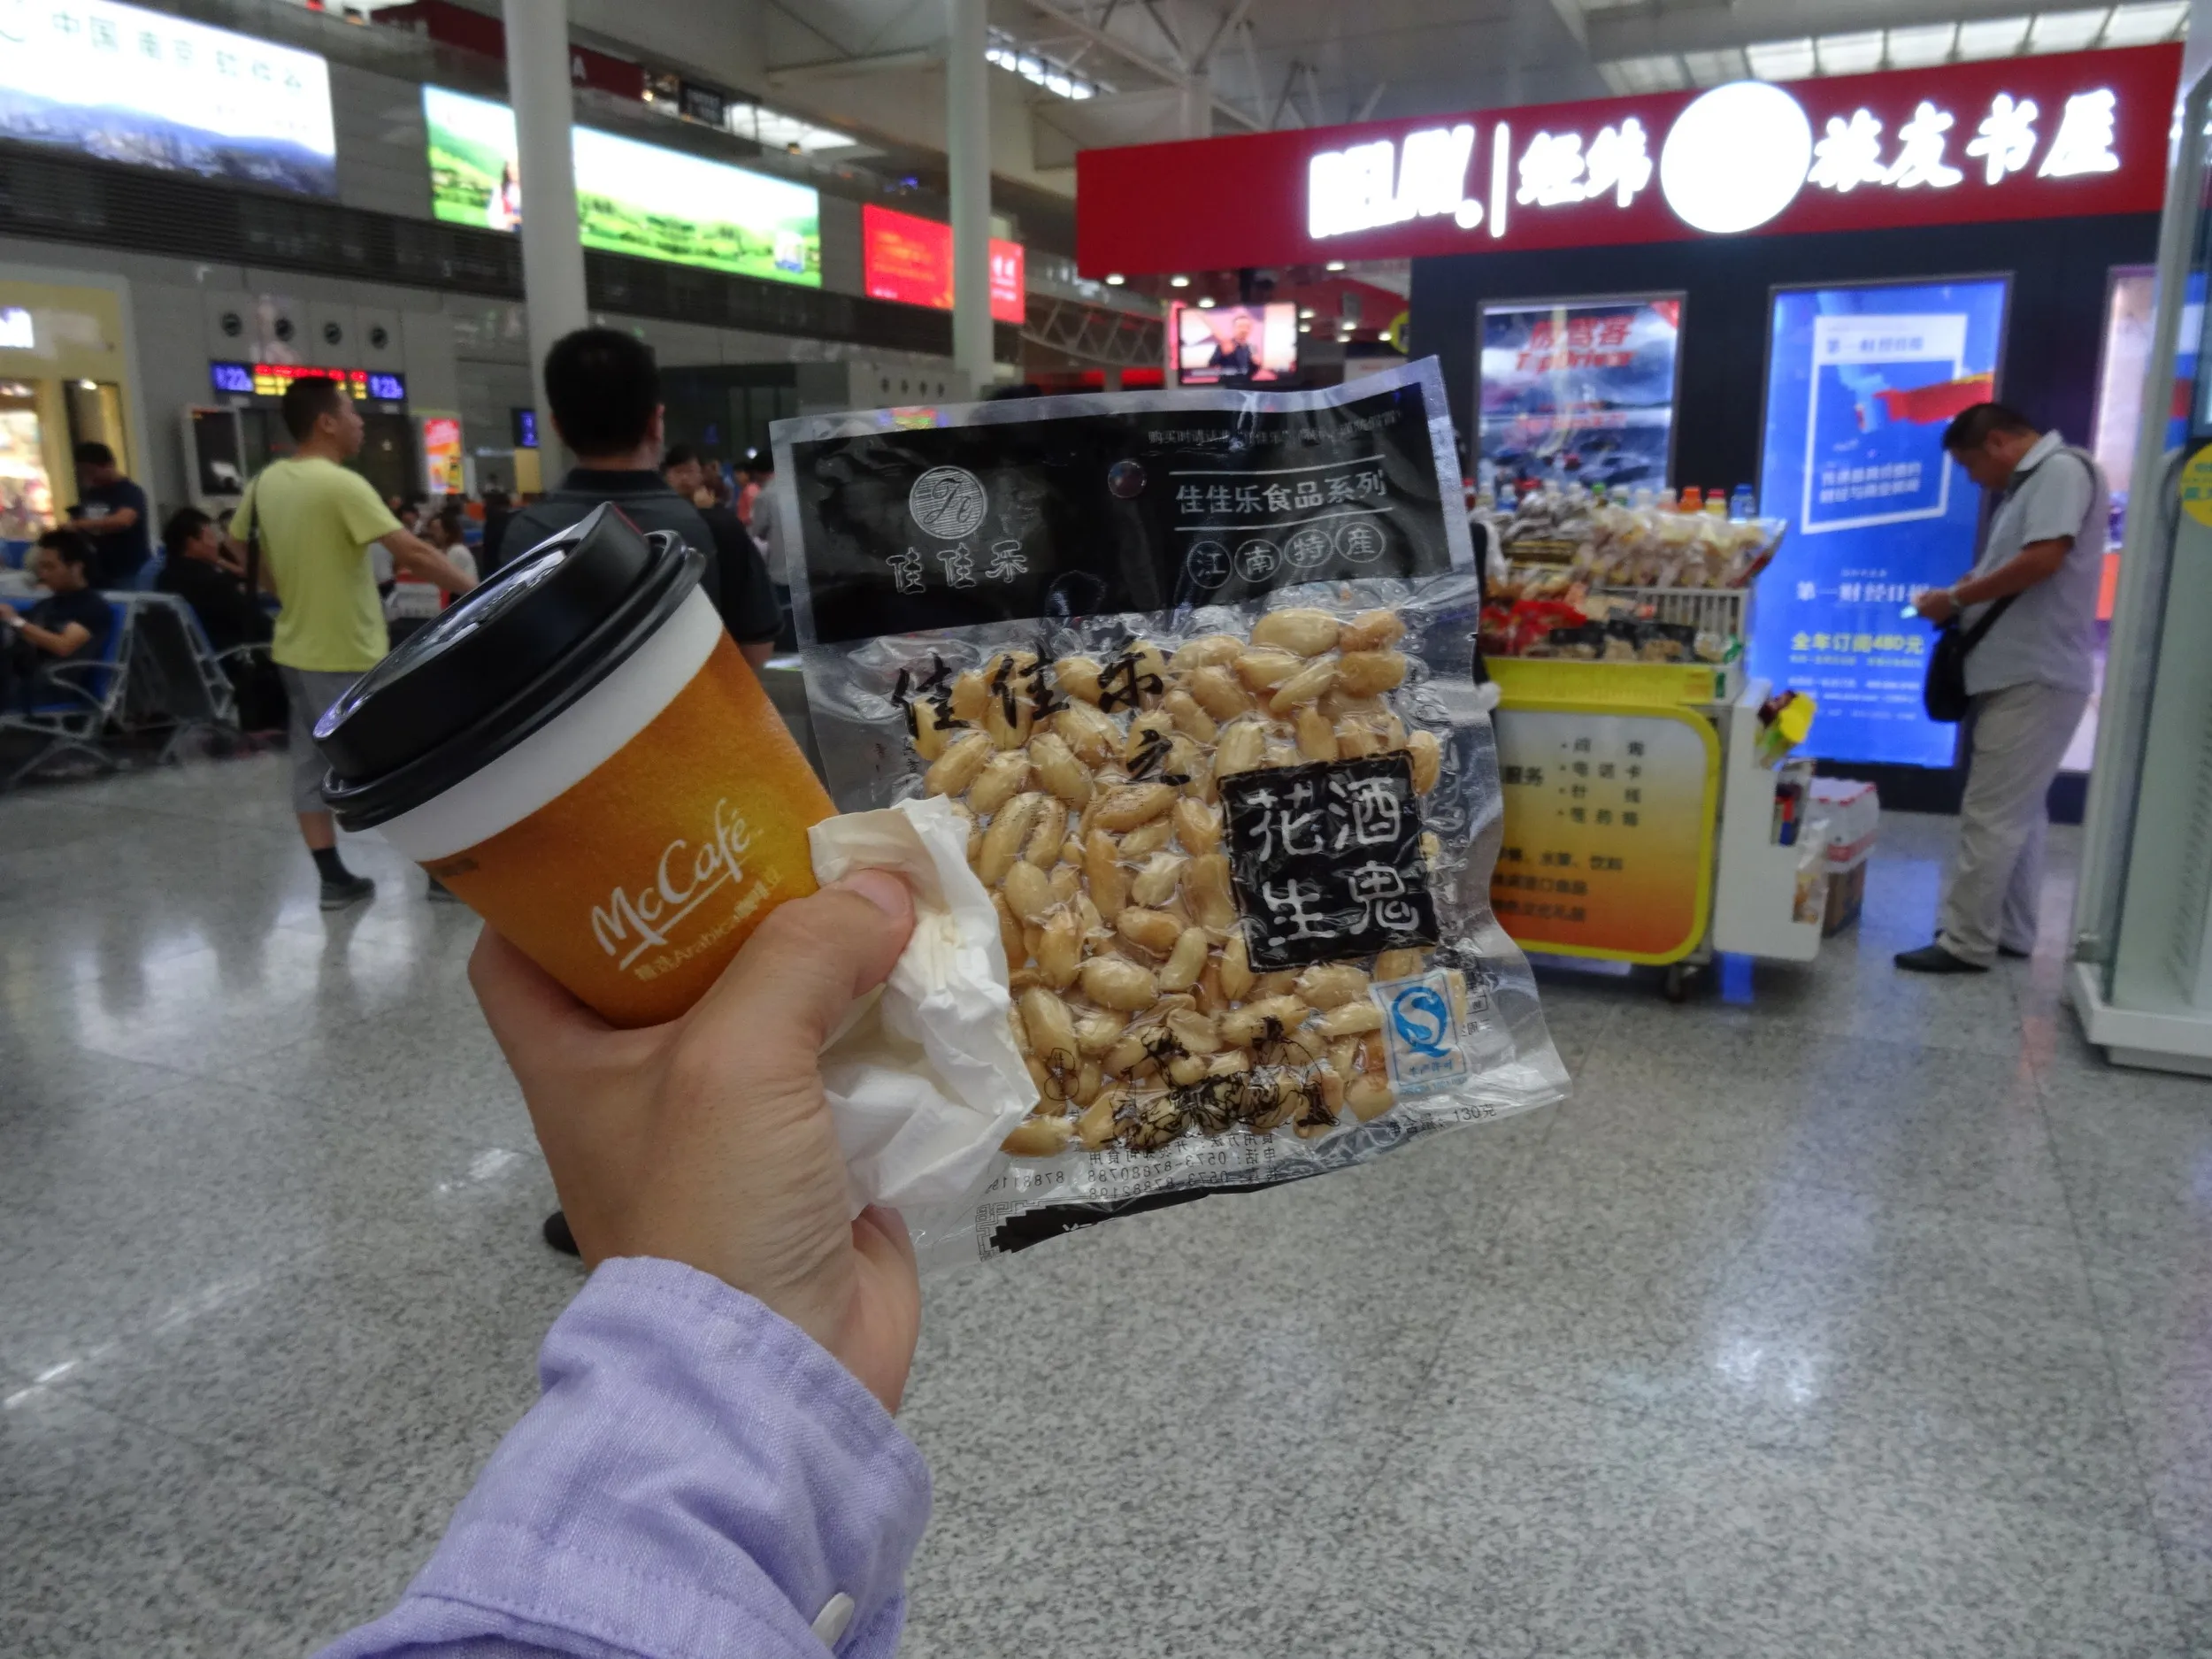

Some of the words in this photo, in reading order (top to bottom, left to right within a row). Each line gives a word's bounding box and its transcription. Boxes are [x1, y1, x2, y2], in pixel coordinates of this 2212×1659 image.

[1175, 469, 1387, 515] 佳佳乐食品系列
[1502, 764, 1545, 787] 服务
[591, 797, 751, 959] McCafé
